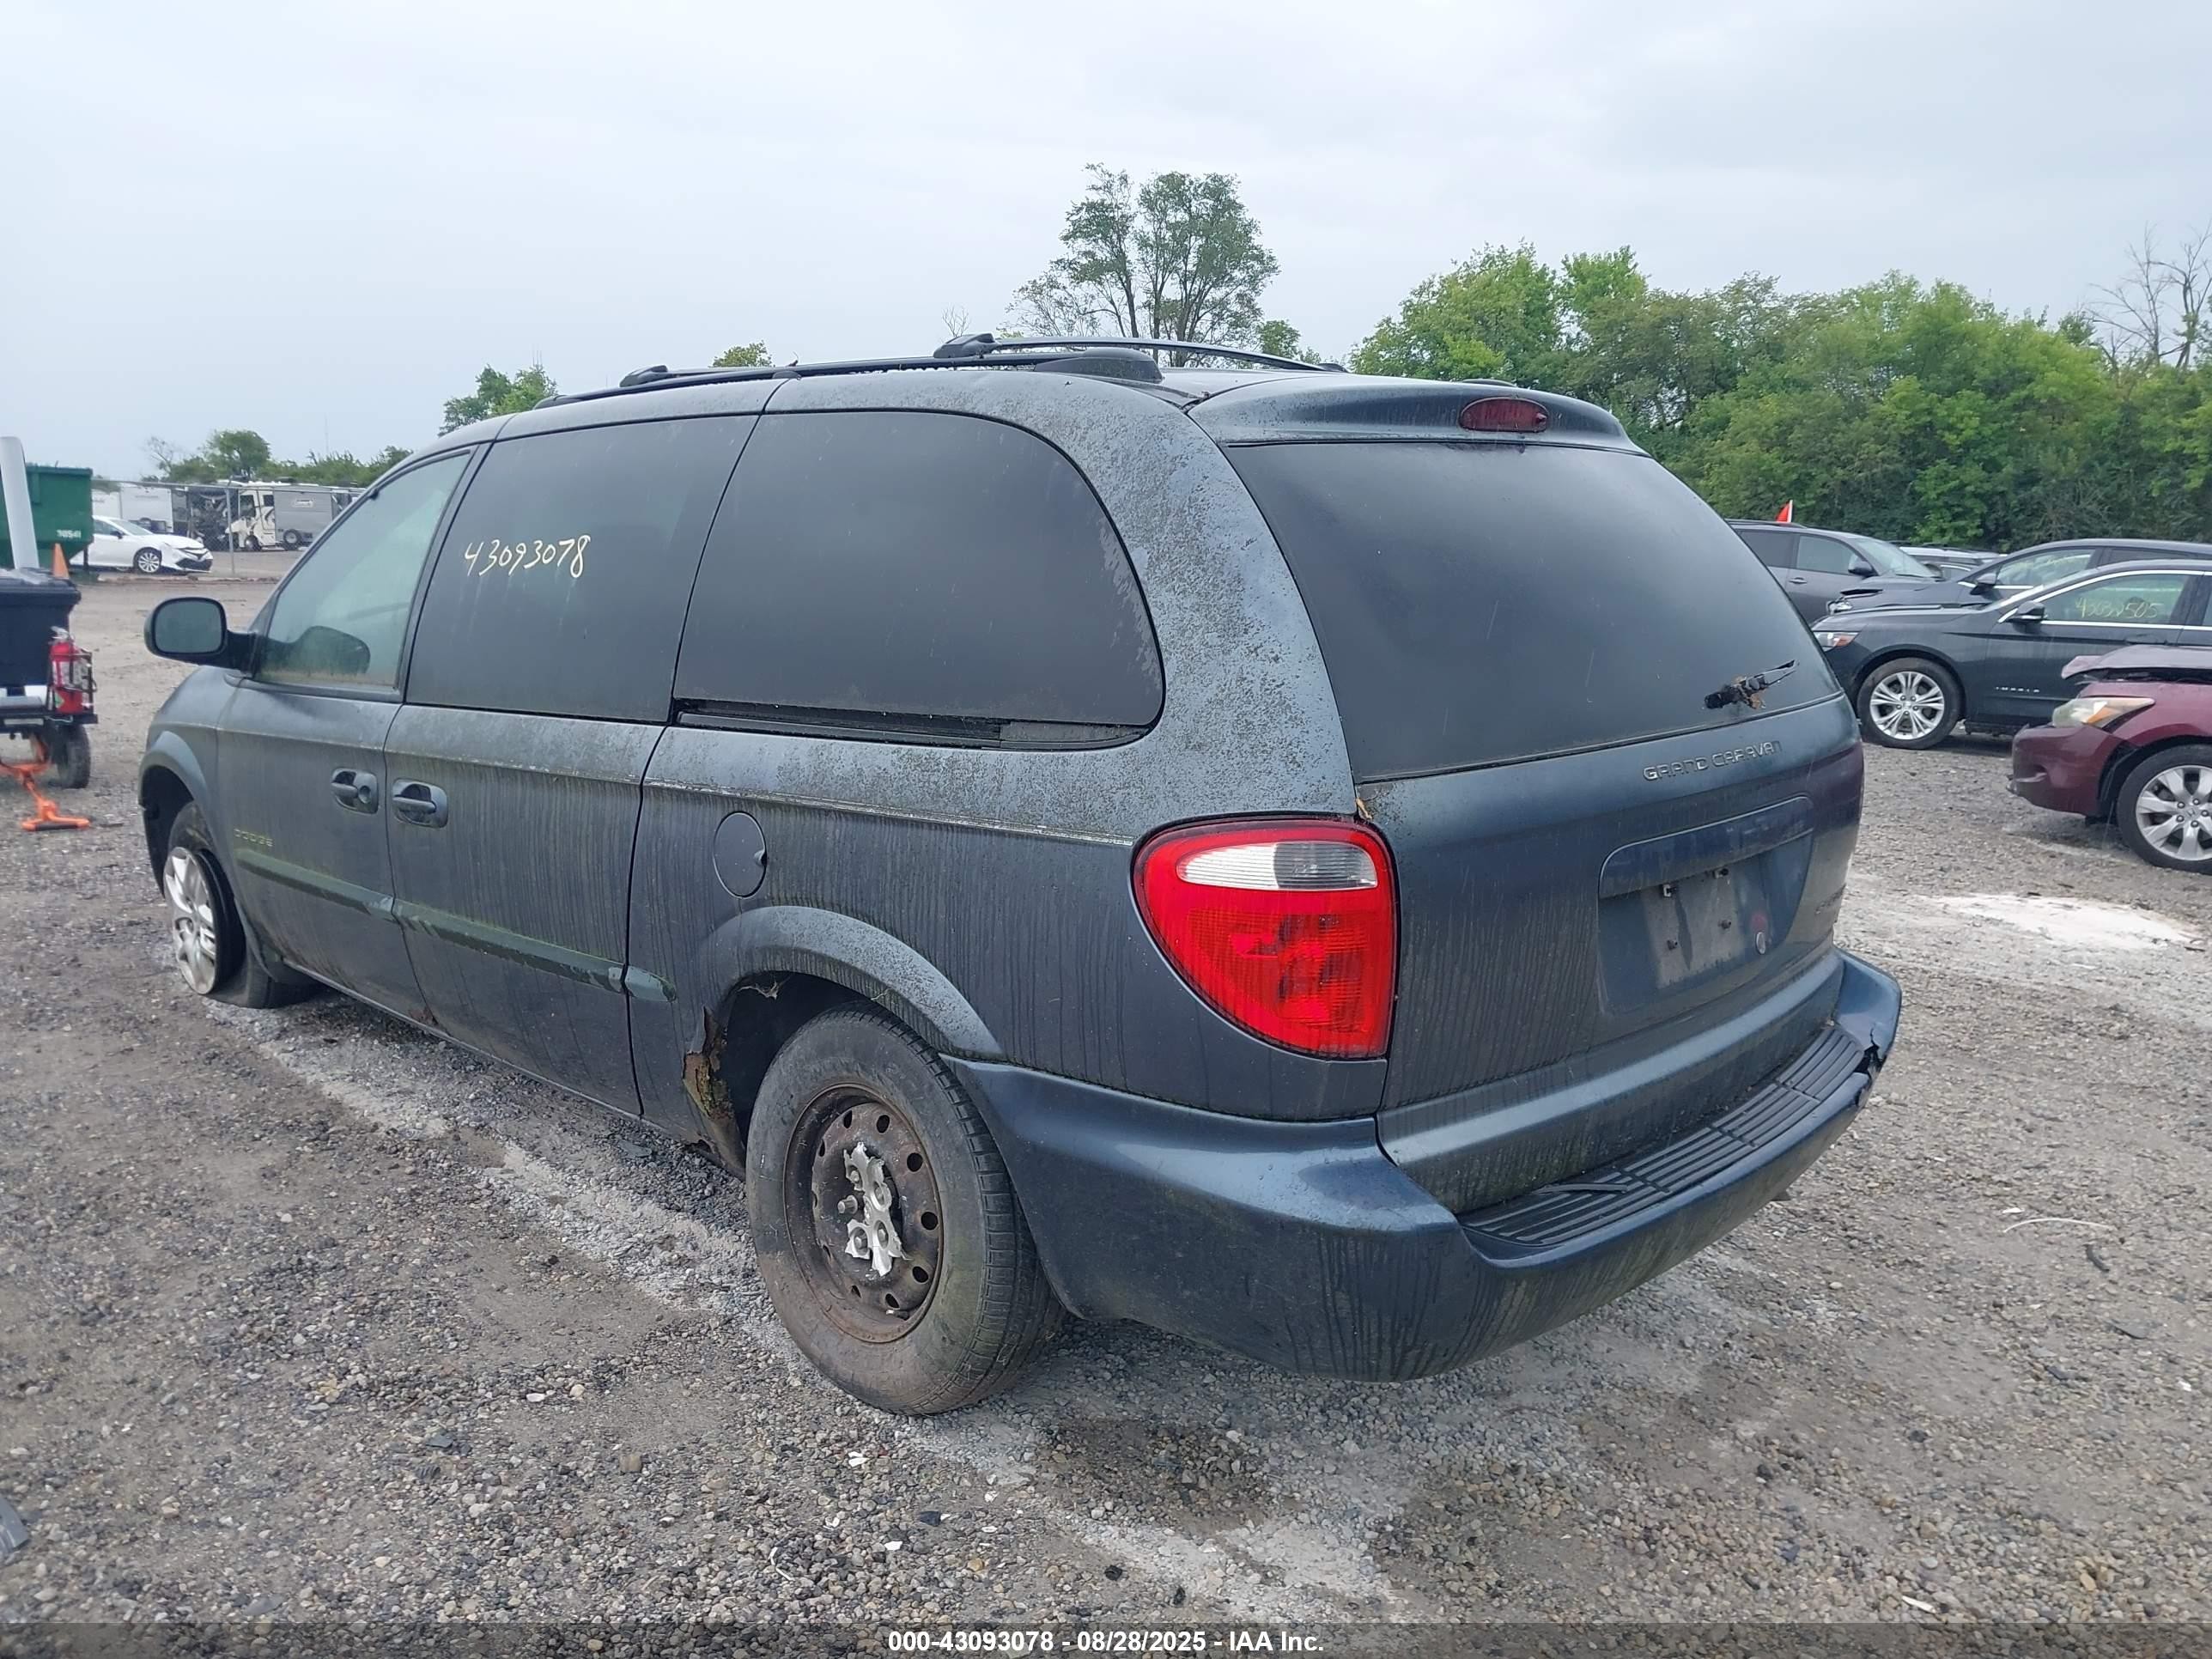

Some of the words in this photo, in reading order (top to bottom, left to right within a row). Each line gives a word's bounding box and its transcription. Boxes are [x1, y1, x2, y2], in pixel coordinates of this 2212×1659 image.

[465, 535, 591, 578] 43093078
[1643, 757, 1709, 781] GRAND
[1711, 740, 1783, 768] CARAVAN
